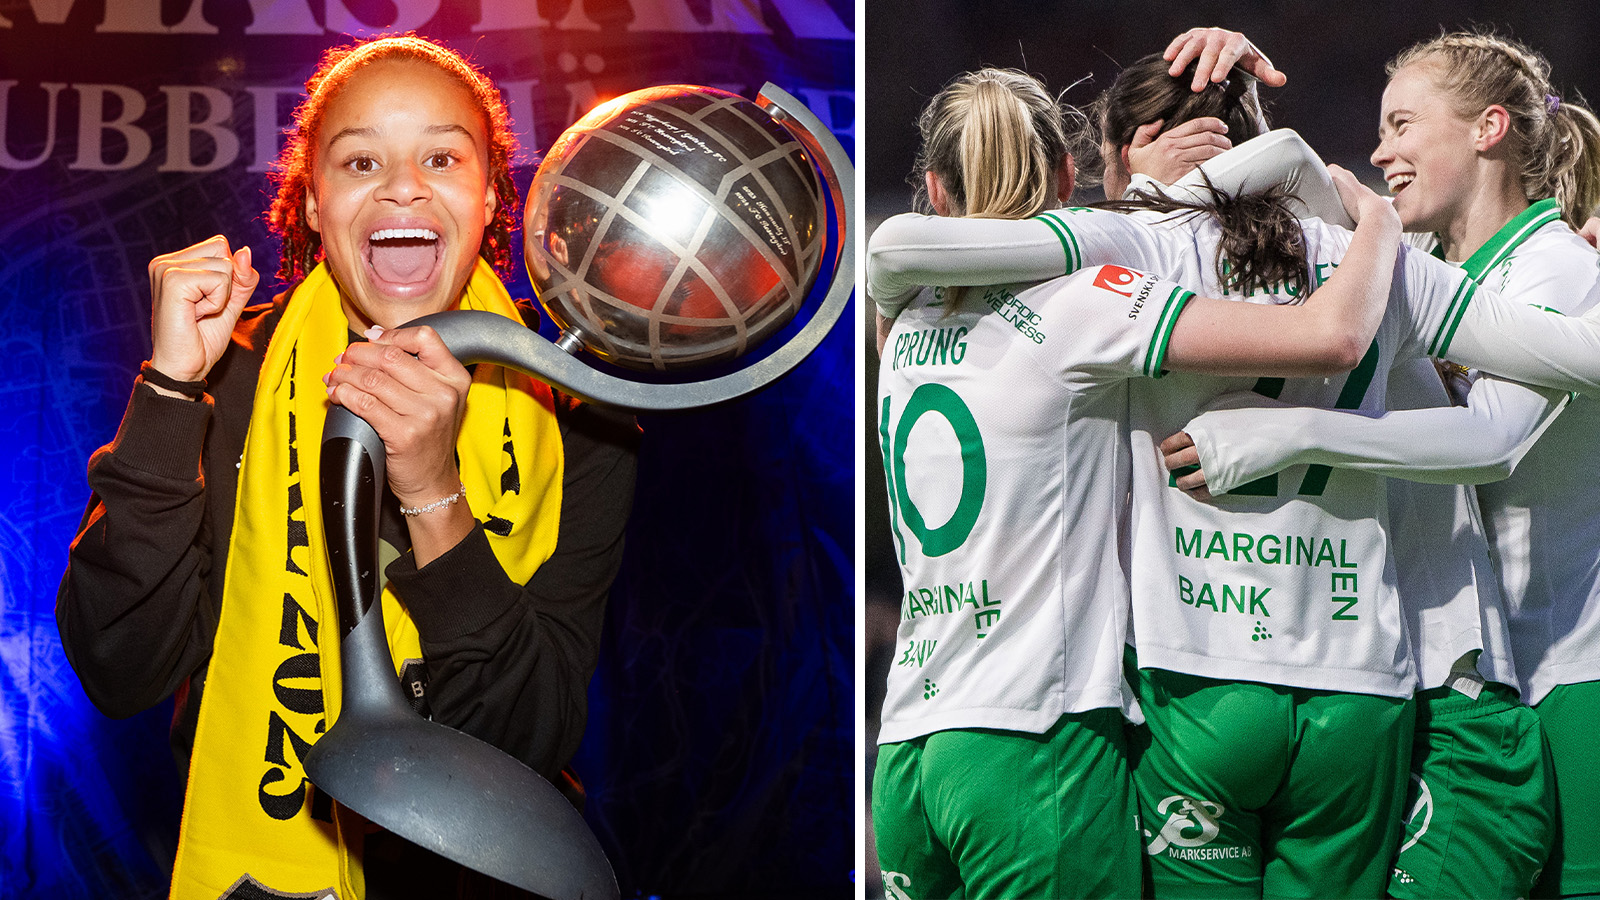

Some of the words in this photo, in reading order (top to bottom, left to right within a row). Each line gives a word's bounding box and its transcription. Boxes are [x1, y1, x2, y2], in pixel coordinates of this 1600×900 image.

[983, 289, 1046, 345] WELLNESS
[997, 288, 1042, 326] NORDIC
[1128, 280, 1157, 321] SVENSKA
[893, 326, 968, 371] SPRUNG
[880, 382, 988, 566] 10
[1175, 526, 1358, 569] MARGINAL
[1178, 574, 1272, 617] BANK
[1331, 572, 1359, 621] EN
[1169, 846, 1240, 861] MARKSERVICE
[1241, 845, 1253, 858] AB
